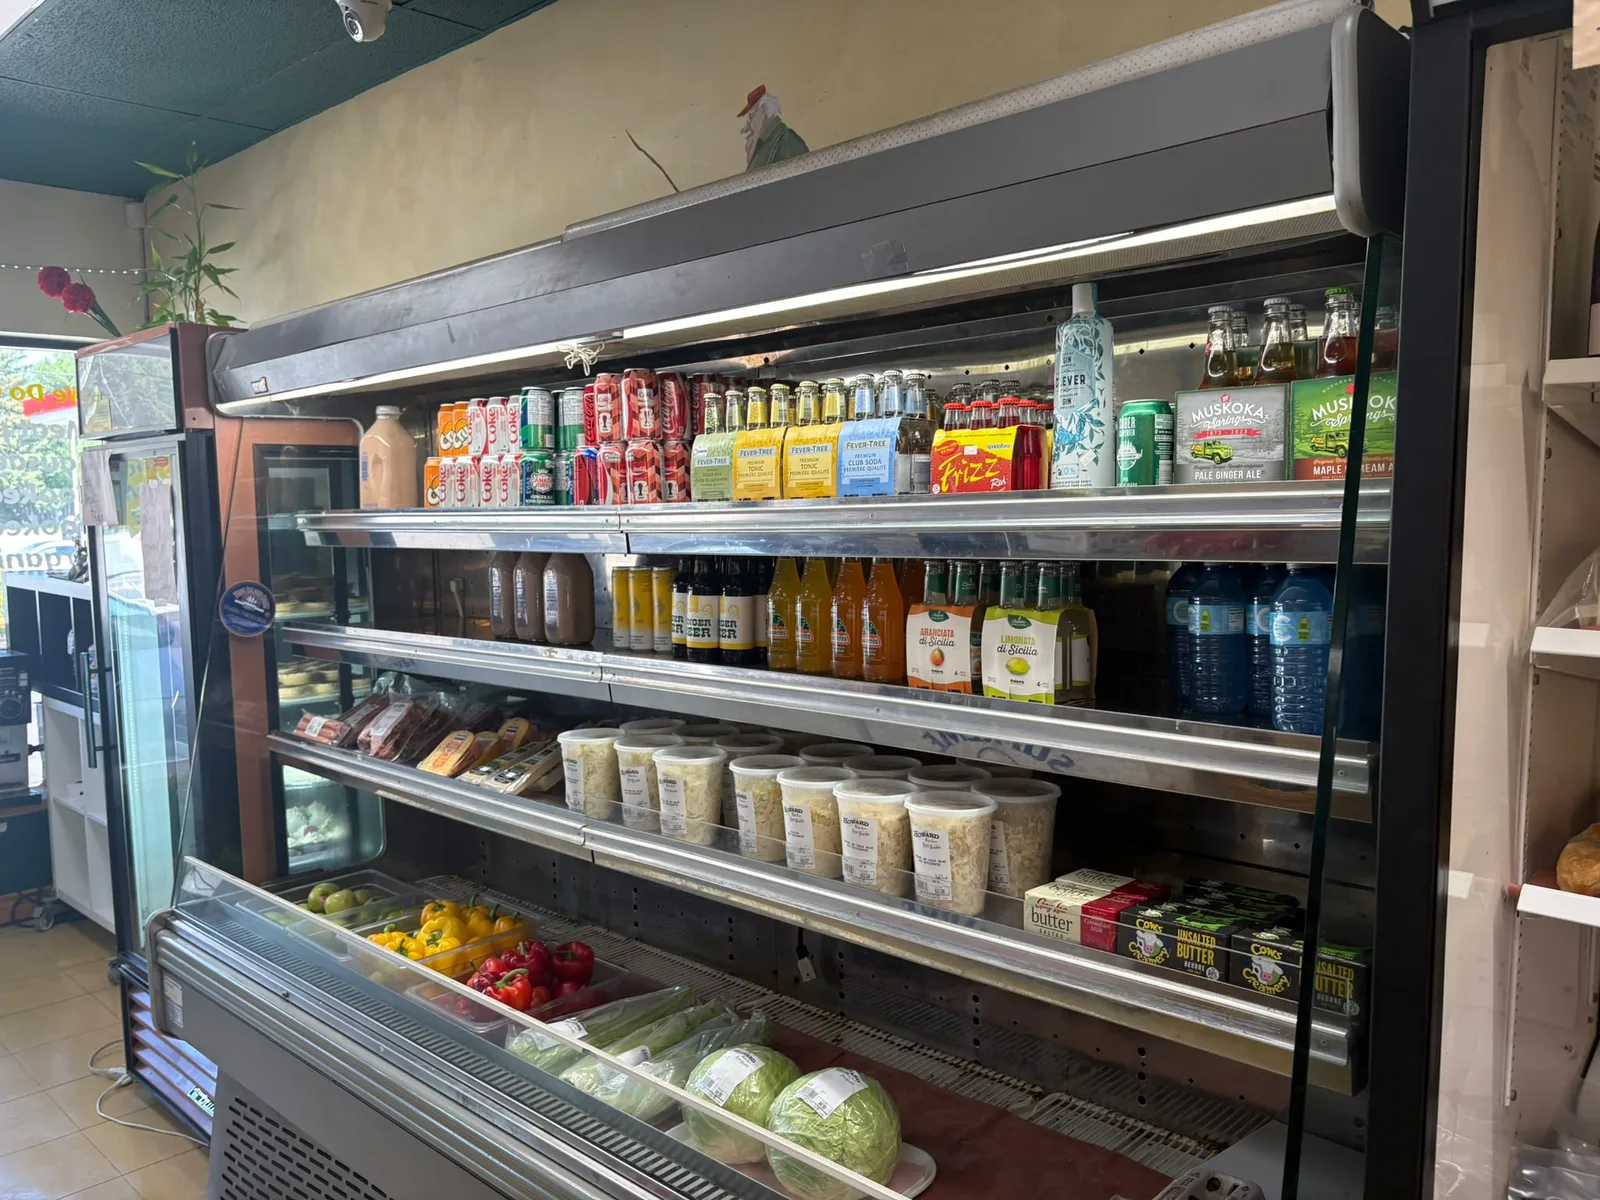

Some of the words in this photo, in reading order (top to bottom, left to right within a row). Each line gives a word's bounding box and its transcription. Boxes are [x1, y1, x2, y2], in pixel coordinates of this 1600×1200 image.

[1191, 402, 1264, 423] MUSKOKA
[487, 407, 497, 445] Coke
[508, 407, 519, 445] Coke
[1196, 413, 1260, 430] Springs
[791, 445, 828, 454] FEVER-TREE
[846, 440, 886, 449] FEVER-TREE
[740, 448, 773, 457] FEVER-TREE
[697, 457, 727, 466] FEVER-TREE
[847, 459, 864, 467] CLUB
[865, 458, 882, 466] SODA
[938, 452, 1000, 492] Frizz
[1194, 471, 1213, 481] PALE
[1215, 471, 1244, 480] GINGER
[1246, 469, 1261, 479] ALE
[1313, 466, 1342, 476] MAPLE
[456, 465, 466, 503] Coke
[481, 465, 492, 503] Coke
[920, 627, 955, 638] ARANCIATA
[919, 636, 928, 645] di
[928, 636, 956, 647] Sicilia
[1001, 634, 1036, 646] LIMONATA
[997, 644, 1007, 654] di
[1008, 643, 1039, 656] Sicilia
[1031, 906, 1073, 932] butter
[1039, 928, 1064, 939] SALTED
[1176, 928, 1216, 948] UNSALTED
[1176, 942, 1215, 966] BUTTER
[1242, 967, 1291, 995] Creamery
